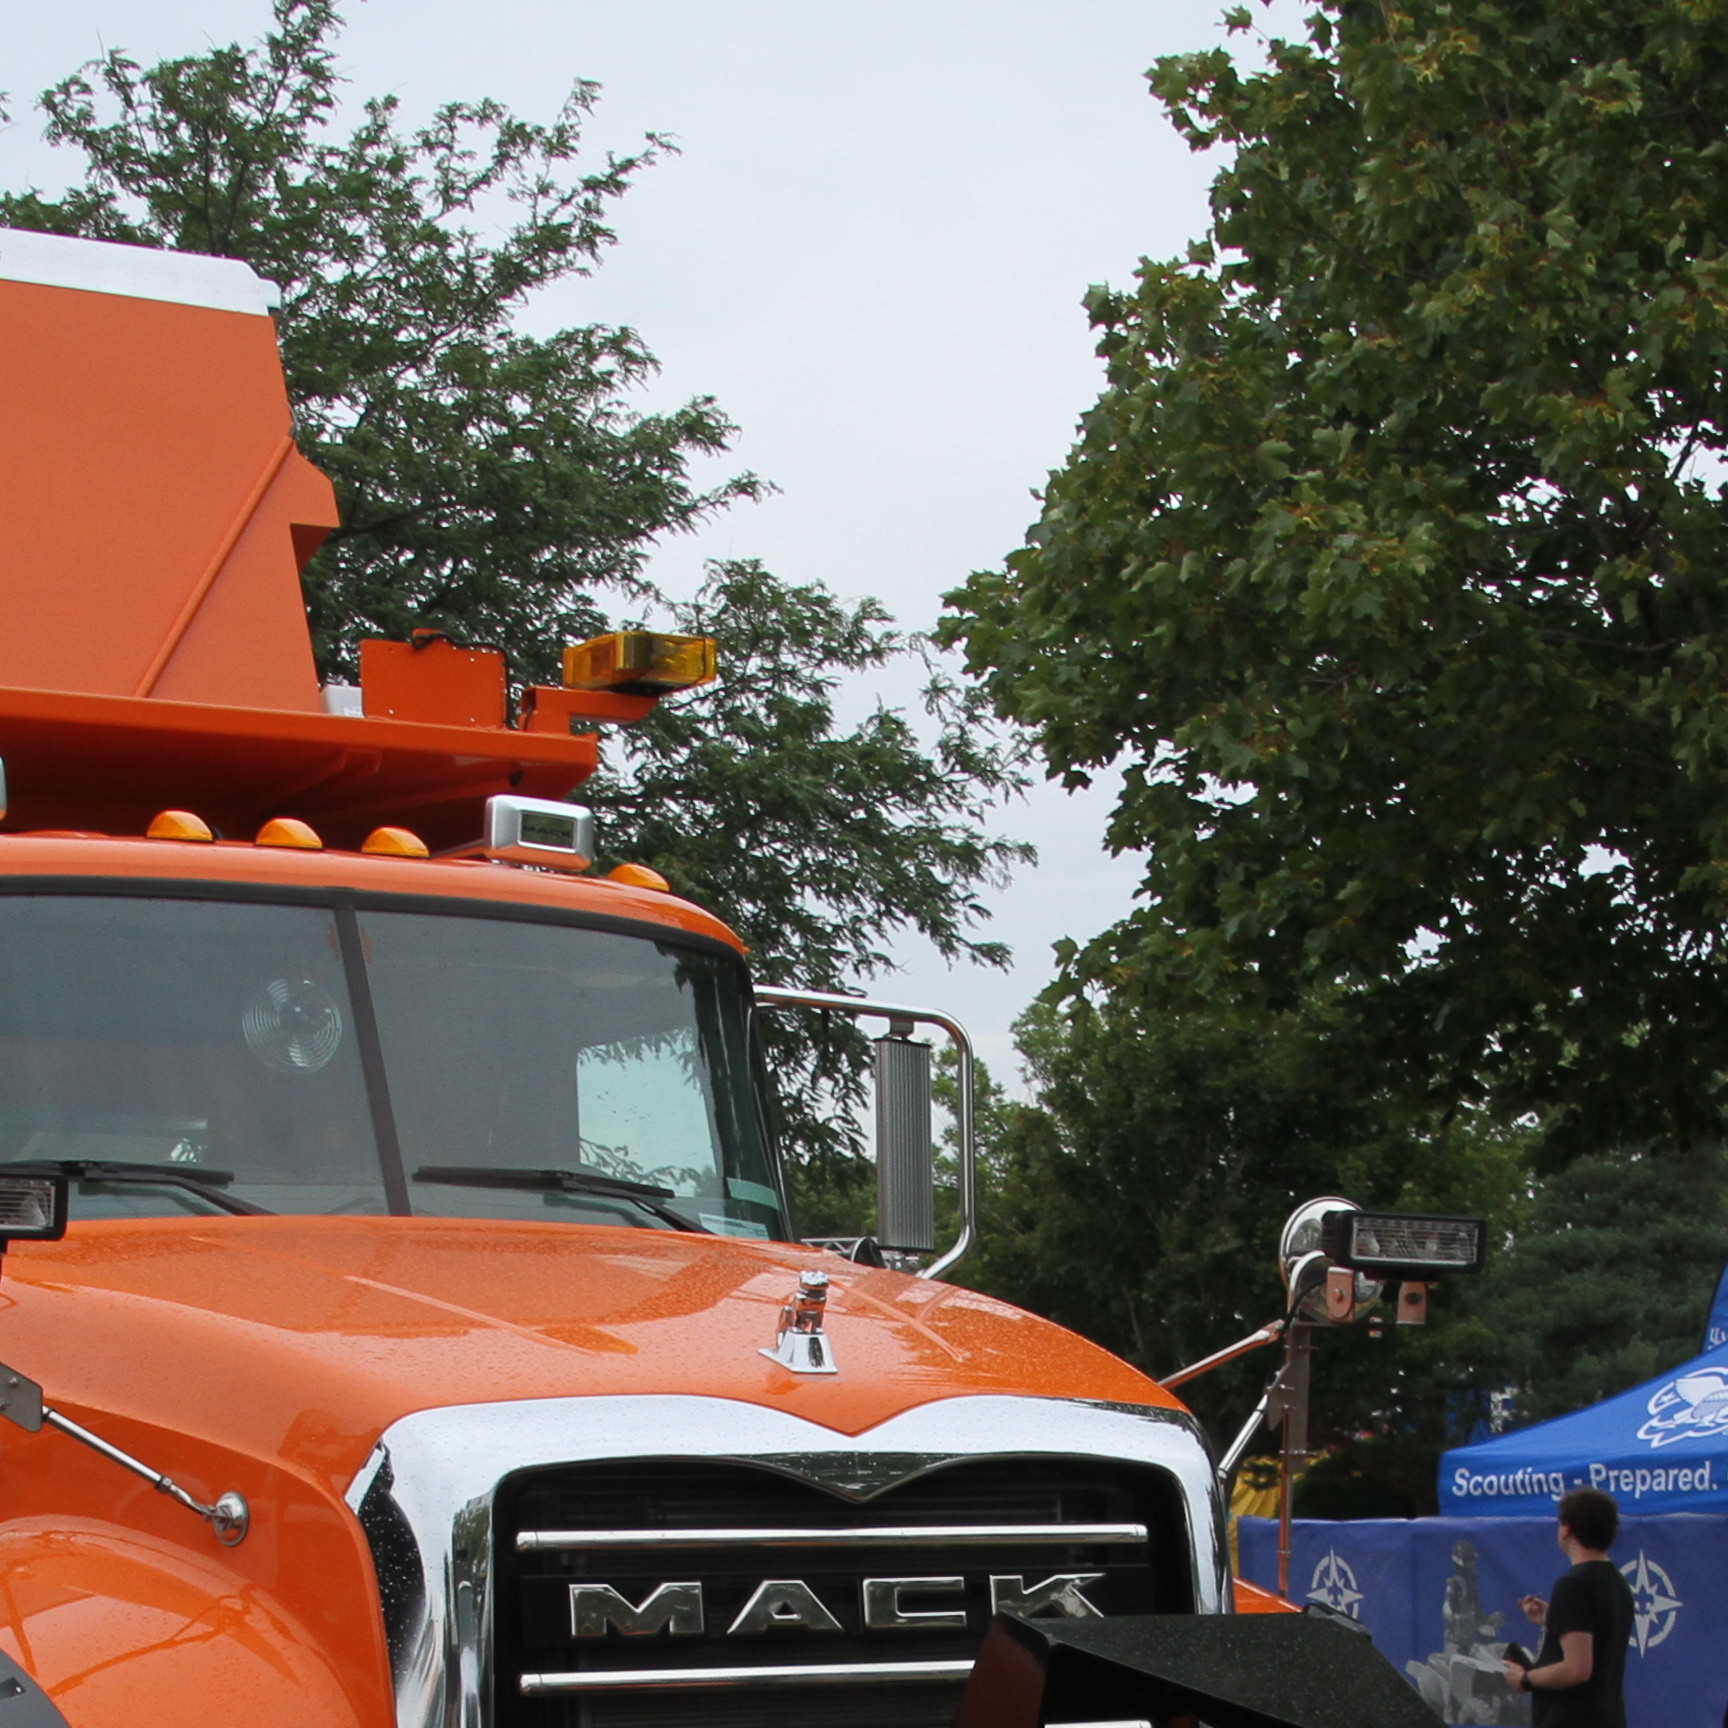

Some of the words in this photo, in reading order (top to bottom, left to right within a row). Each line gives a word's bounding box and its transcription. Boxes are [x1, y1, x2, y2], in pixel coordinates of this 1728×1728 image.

[1452, 1467, 1565, 1500] Scouting
[1589, 1460, 1718, 1499] Prepared.
[569, 1573, 1107, 1638] MACK
